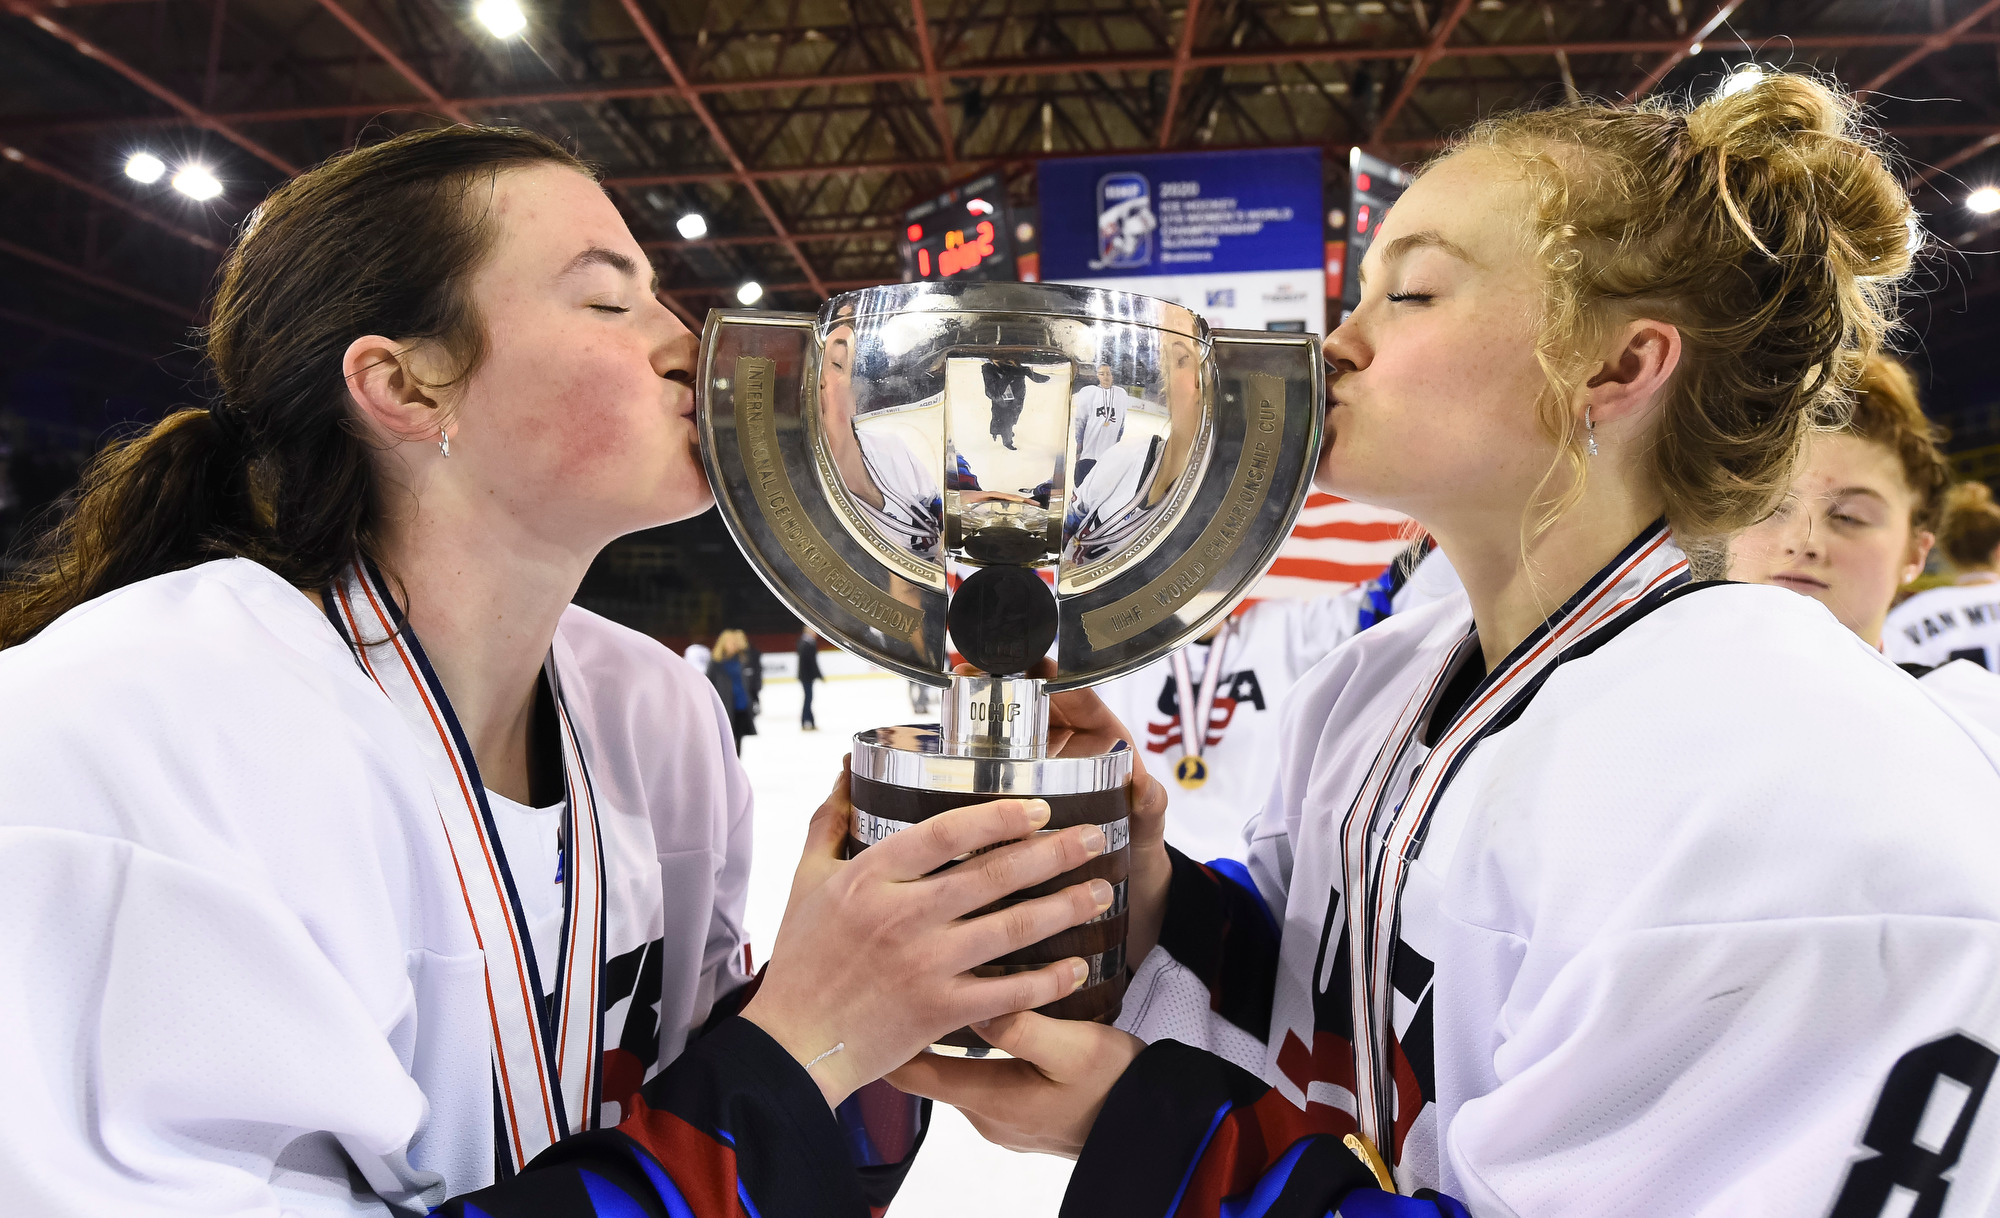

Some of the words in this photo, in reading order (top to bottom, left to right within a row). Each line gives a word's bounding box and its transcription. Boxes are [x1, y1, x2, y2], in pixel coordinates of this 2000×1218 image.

[747, 365, 778, 492] INTERNATIONAL
[768, 490, 790, 519] ICE
[781, 516, 832, 573] HOCKEY
[824, 567, 915, 633] FEDERATION
[1153, 562, 1205, 608] WORLD
[1204, 442, 1271, 561] CHAMPIONSHIP
[1258, 398, 1278, 434] CUP
[969, 701, 1021, 722] IIHF
[1820, 1027, 2000, 1218] 8
